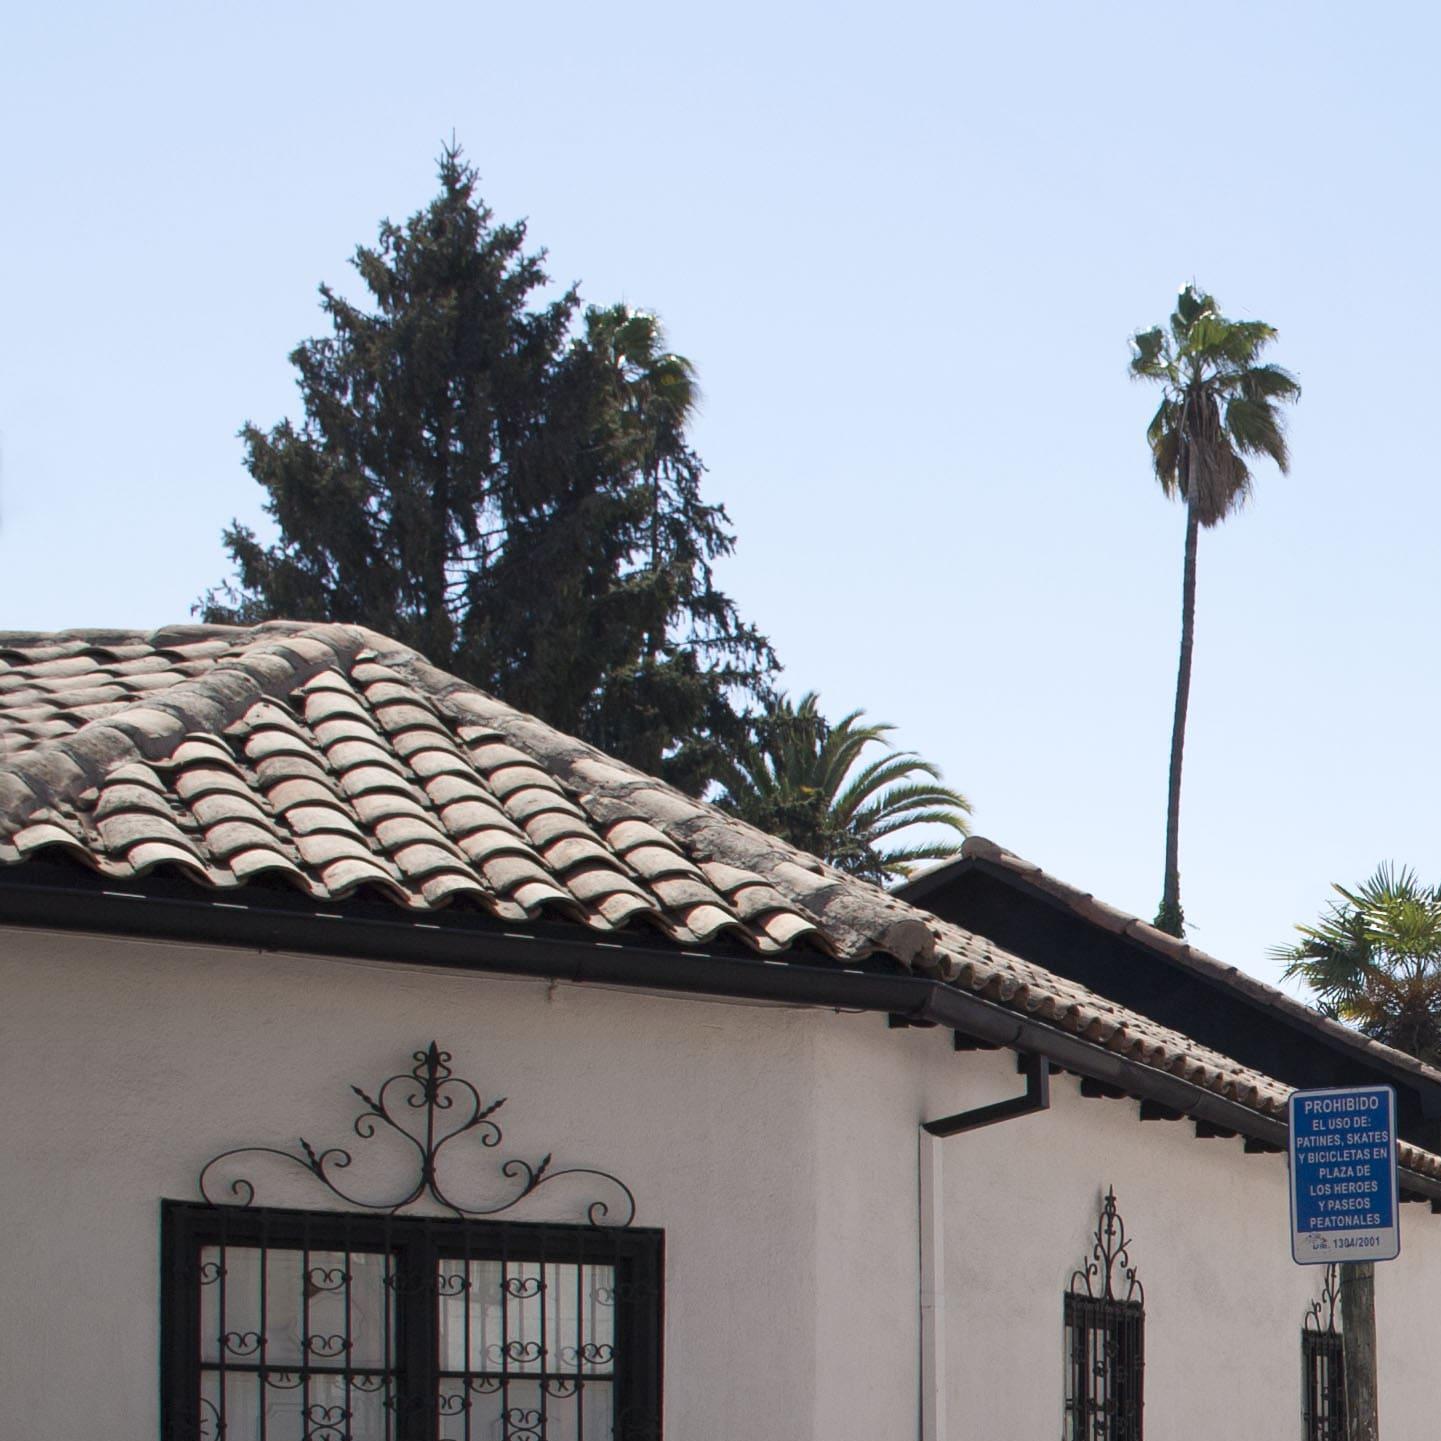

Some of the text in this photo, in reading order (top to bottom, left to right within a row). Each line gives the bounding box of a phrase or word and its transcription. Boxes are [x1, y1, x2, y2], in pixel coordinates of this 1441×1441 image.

[1305, 1096, 1379, 1114] PROHIBIDO
[1313, 1116, 1371, 1131] EL USO DE:
[1297, 1131, 1389, 1148] PATINES, SKATES
[1299, 1148, 1387, 1164] Y BICICLETAS EN
[1320, 1165, 1371, 1179] PLAZA DE
[1310, 1181, 1378, 1196] LOS HEROES
[1319, 1198, 1371, 1212] Y PASEOS
[1310, 1214, 1380, 1228] PEATONALES
[1333, 1236, 1380, 1249] 1304/2001
